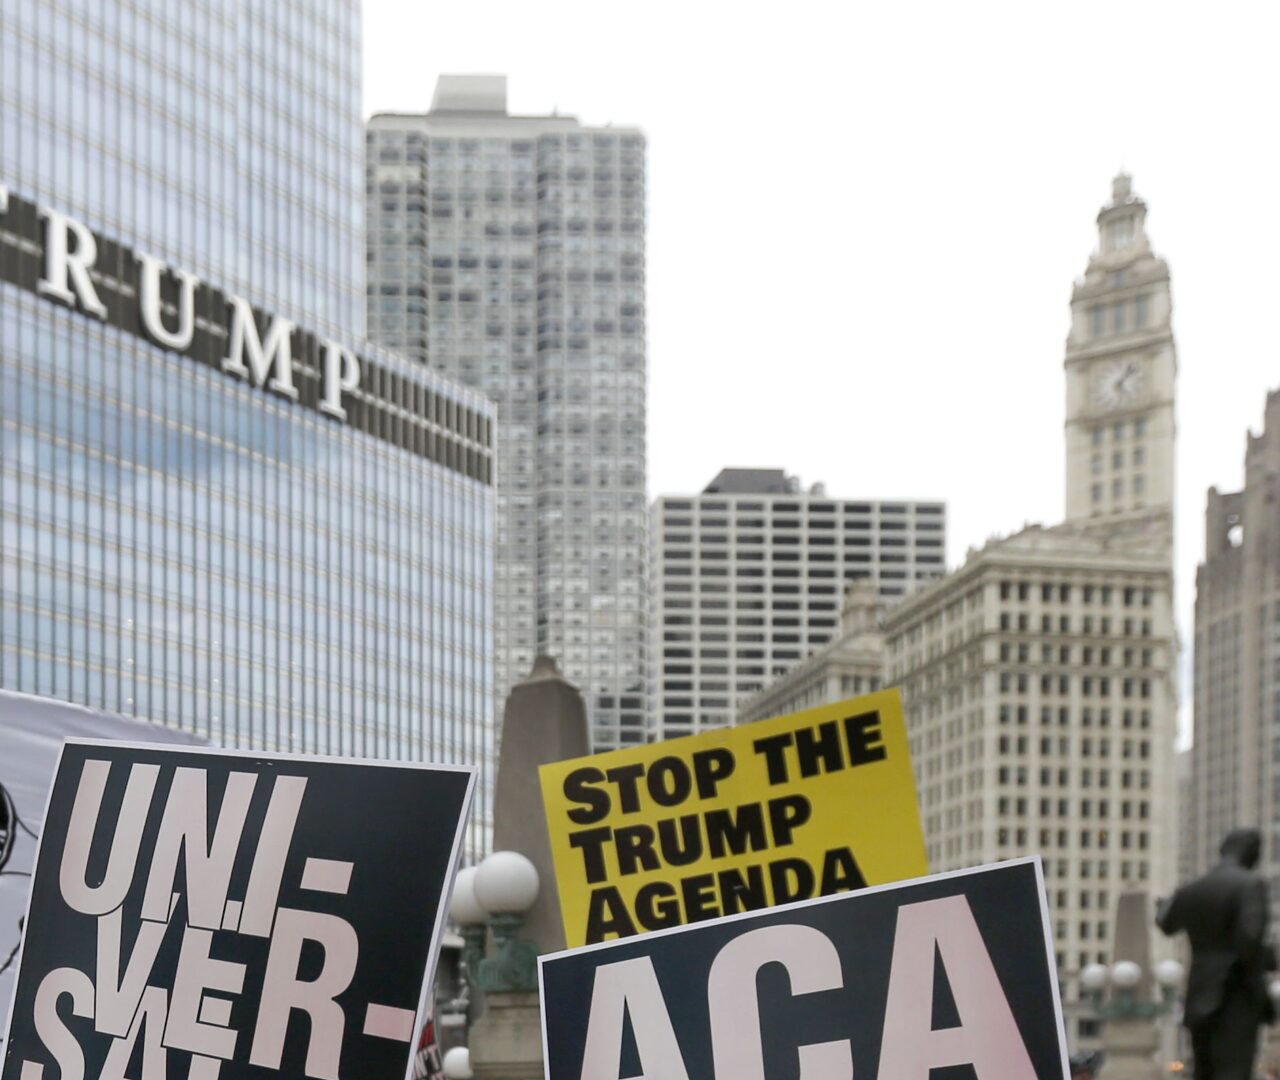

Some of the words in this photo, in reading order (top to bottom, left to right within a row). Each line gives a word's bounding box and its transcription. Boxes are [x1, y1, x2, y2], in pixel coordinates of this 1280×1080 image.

[563, 747, 736, 825] STOP
[753, 709, 887, 786] THE
[57, 758, 355, 938] UNI-
[568, 793, 812, 884] TRUMP
[585, 846, 868, 946] AGENDA
